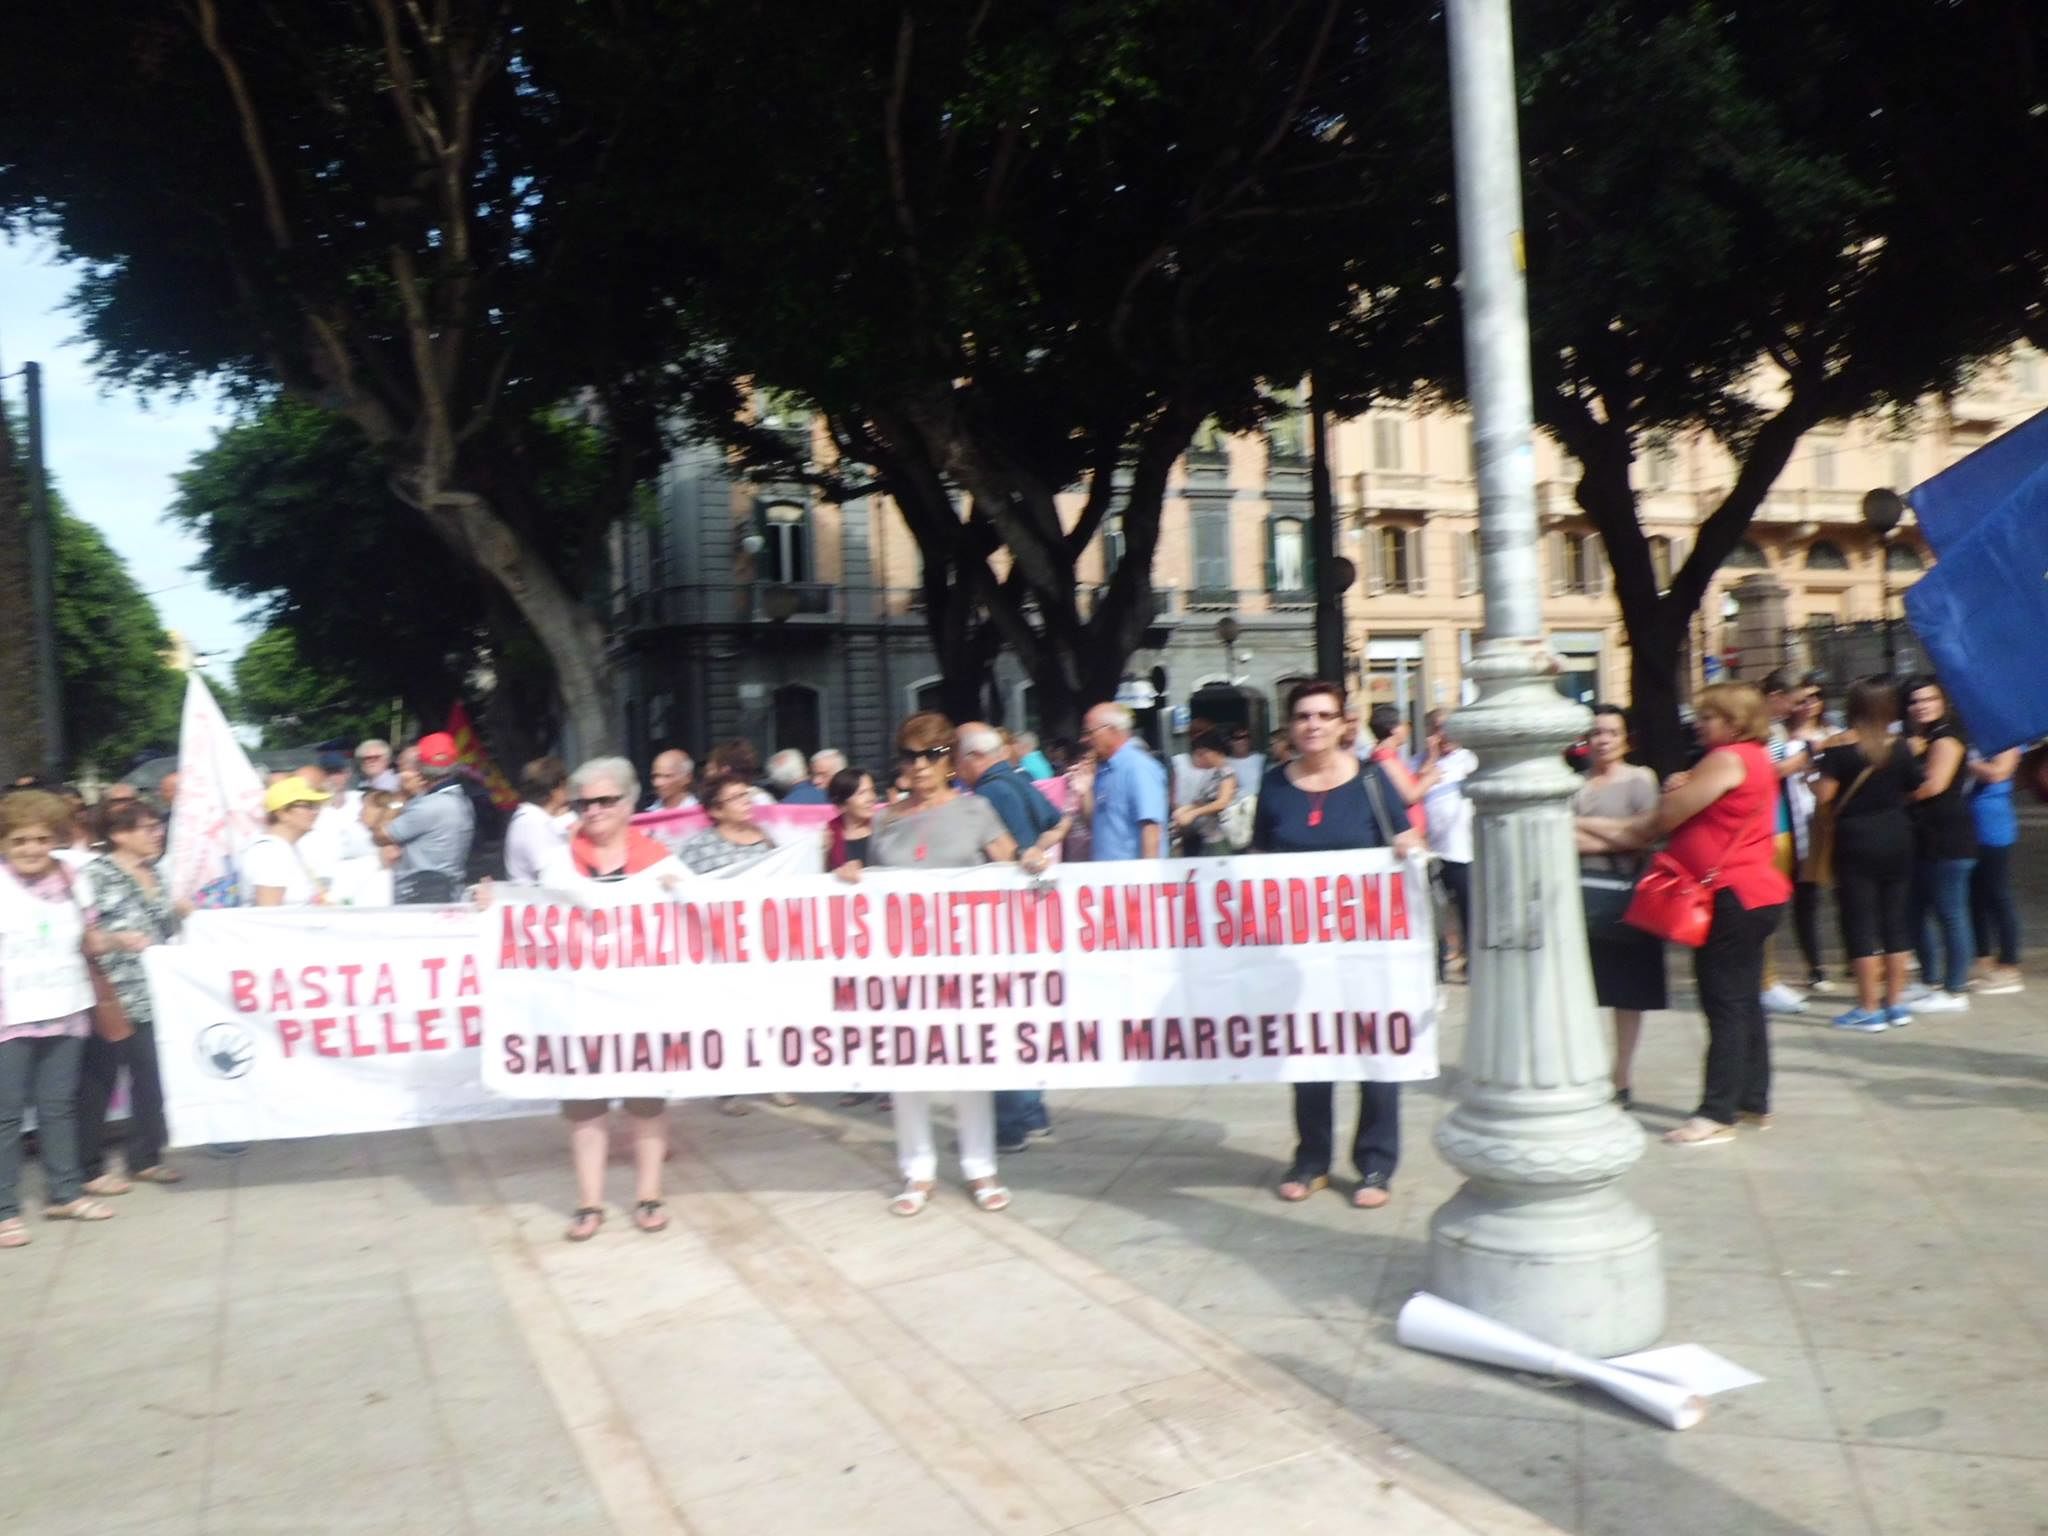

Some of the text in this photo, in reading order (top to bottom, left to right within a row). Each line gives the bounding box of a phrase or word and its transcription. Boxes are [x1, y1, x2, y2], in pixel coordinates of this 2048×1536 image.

[498, 899, 749, 970] ASSOCIAZIONE
[762, 893, 871, 962] ONLUS
[886, 887, 1064, 958] OBIETTIVO
[1216, 872, 1409, 947] SARDEGNA
[230, 962, 396, 1013] BASTA
[832, 970, 1064, 1011] MOVIMENTO
[503, 1011, 1412, 1075] SALVIAMO L'OSPEDALE SAN MARCELLINO
